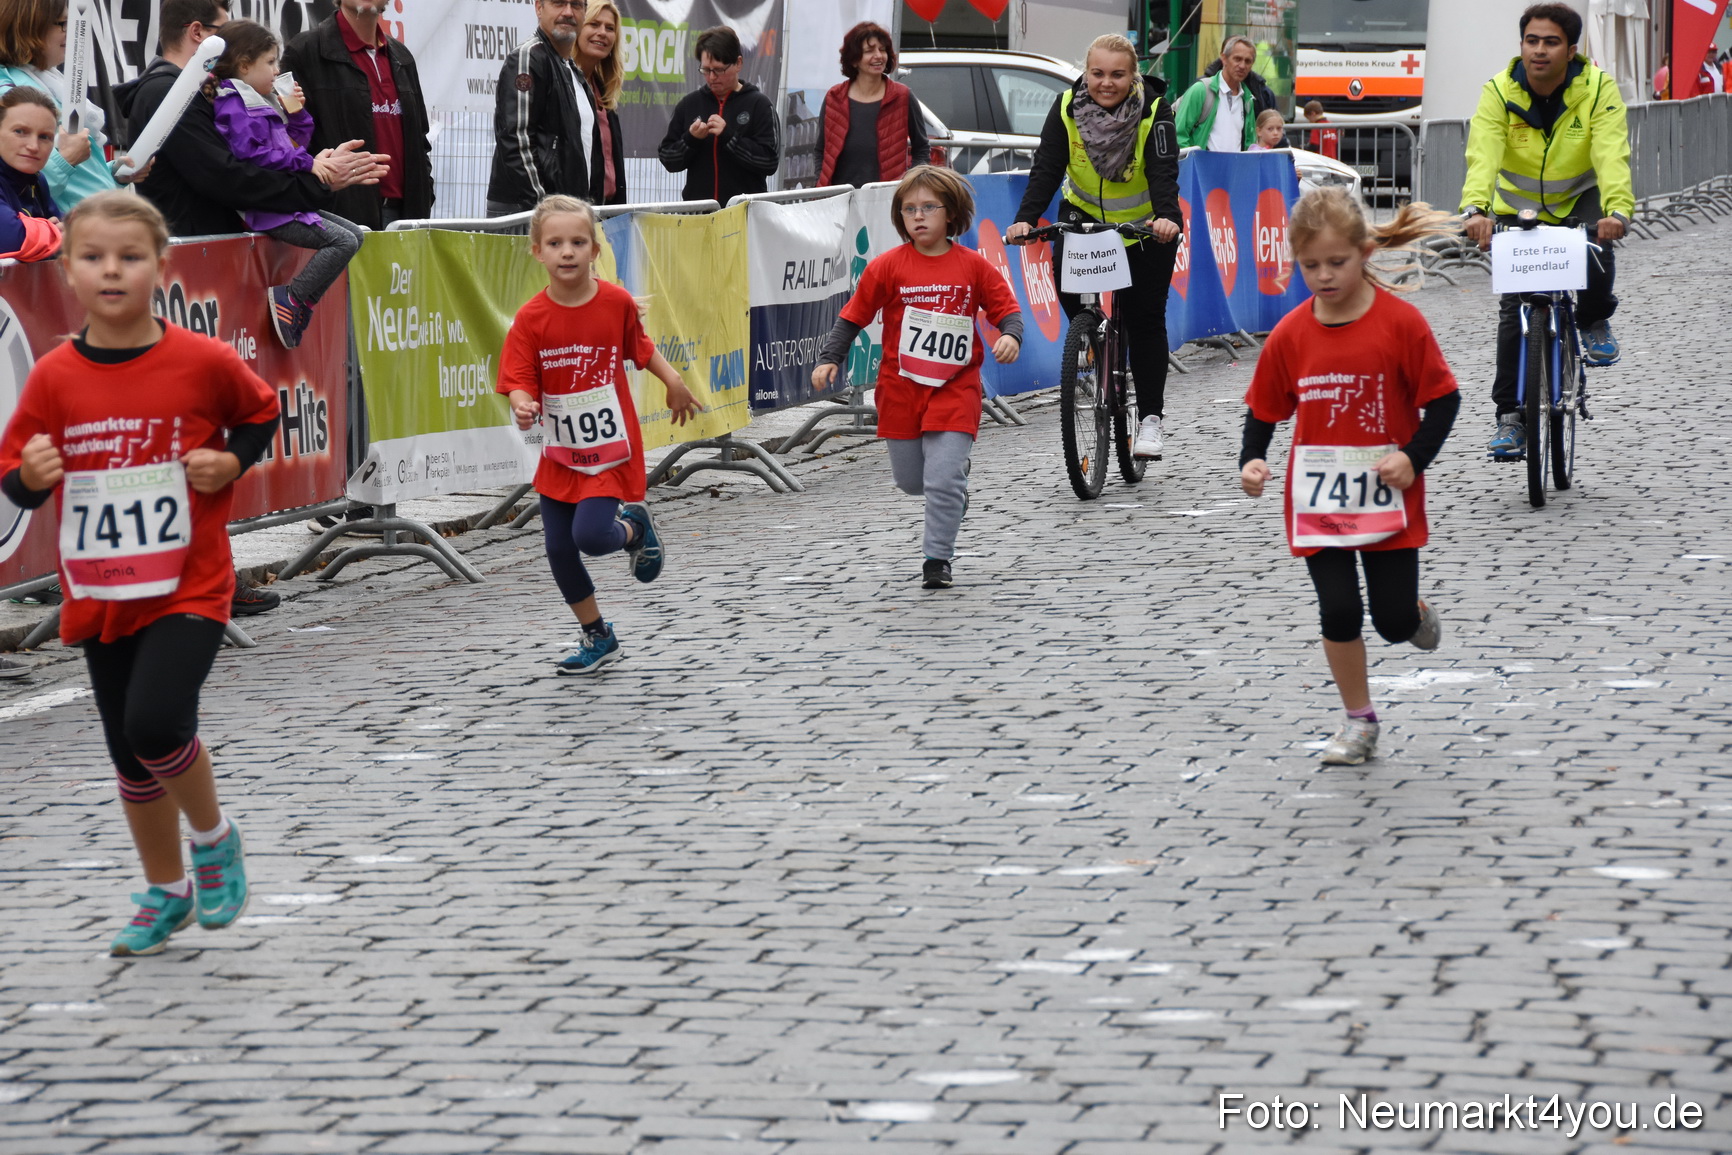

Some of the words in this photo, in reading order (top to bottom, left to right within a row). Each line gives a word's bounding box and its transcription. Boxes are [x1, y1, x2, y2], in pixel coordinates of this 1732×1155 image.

[1067, 250, 1088, 260] Erster
[1090, 247, 1117, 259] Mann
[1513, 247, 1540, 256] Erste
[1543, 246, 1567, 254] Frau
[1069, 262, 1117, 277] Jugendlauf
[1511, 260, 1570, 274] Jugendlauf
[390, 262, 413, 294] Der
[900, 284, 951, 294] Neumarkter
[368, 295, 419, 351] Neue
[936, 316, 970, 328] BOCK
[908, 325, 968, 361] 7406
[566, 389, 610, 408] BOCK
[279, 381, 328, 458] Hits
[548, 407, 617, 444] 7193
[572, 450, 600, 464] Clara
[1343, 450, 1386, 462] BOC
[106, 467, 173, 490] BOCK
[1305, 472, 1393, 508] 7418
[73, 496, 180, 550] 7412
[1319, 515, 1358, 533] Sophia
[86, 559, 136, 579] Tonia
